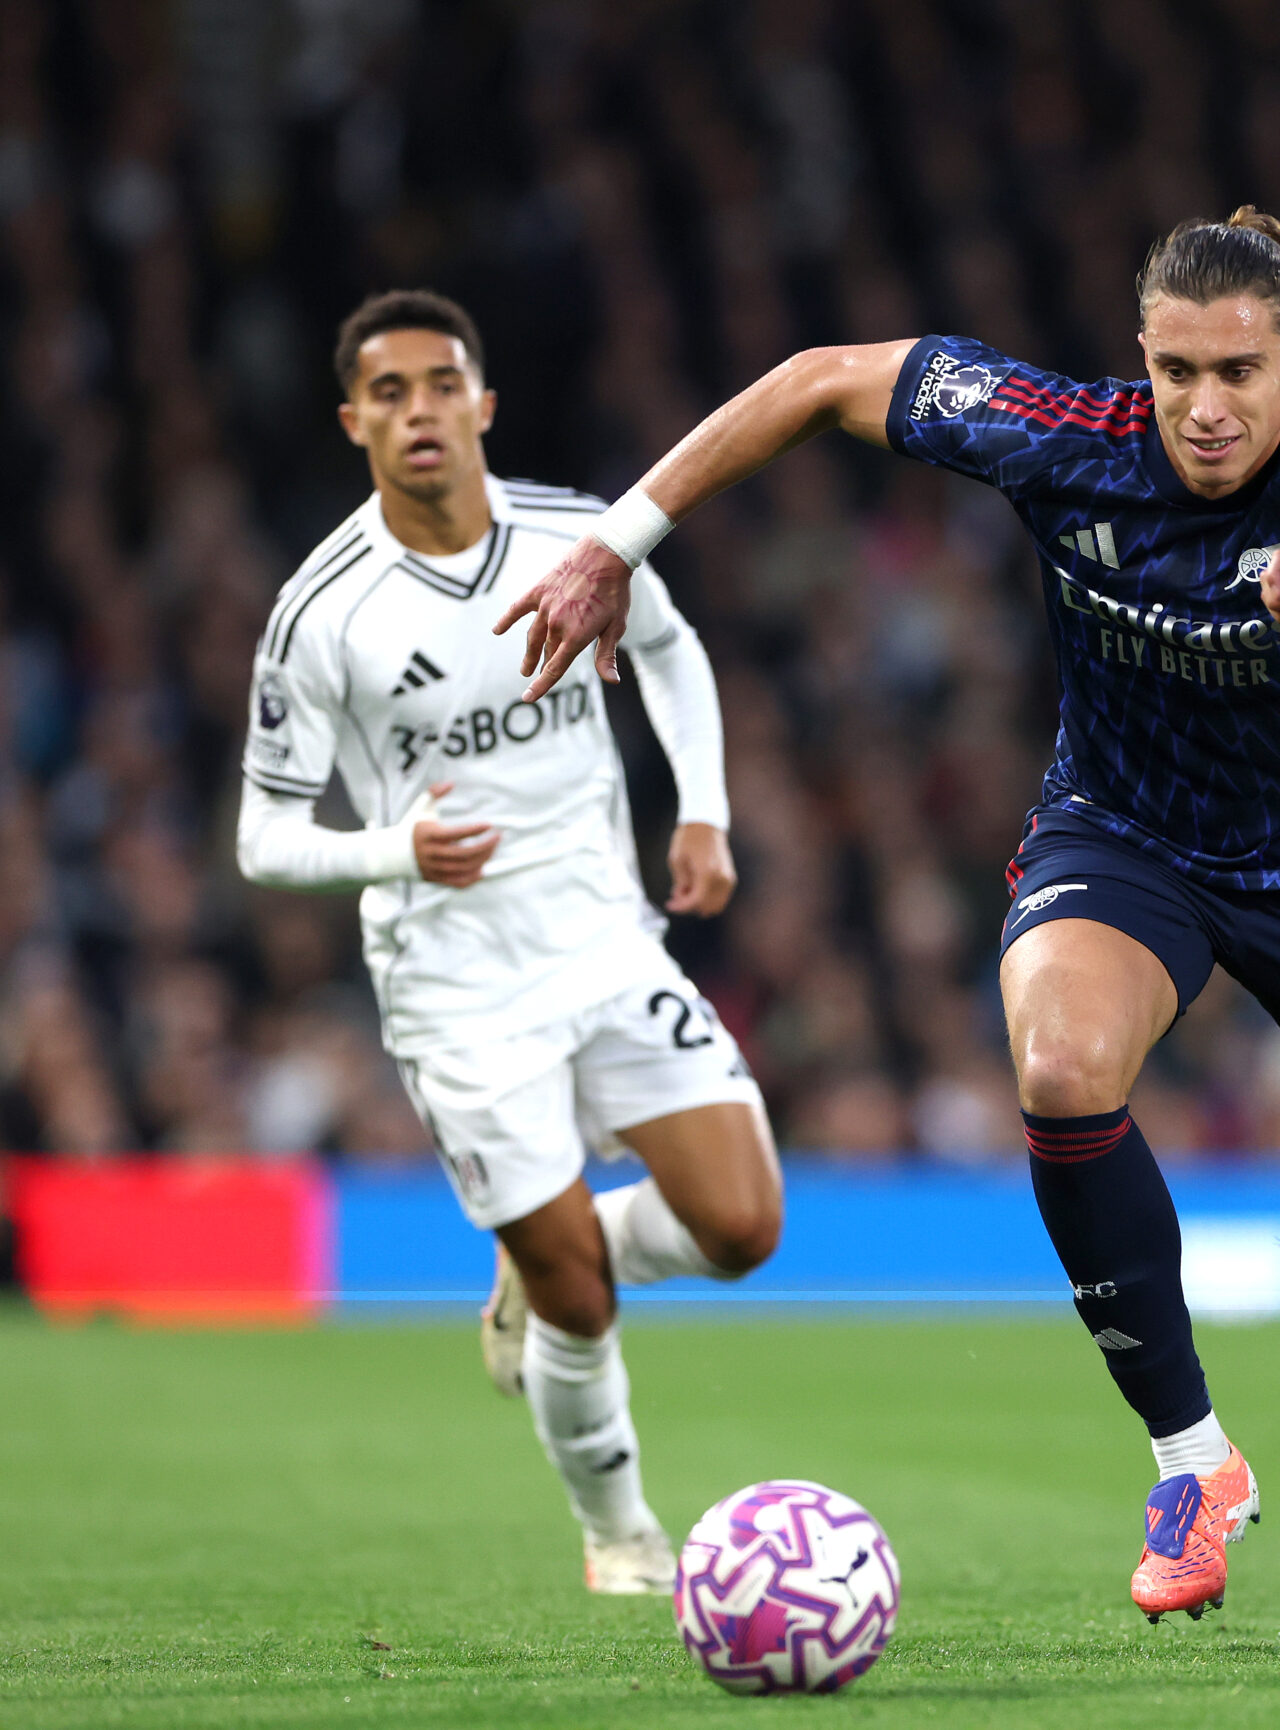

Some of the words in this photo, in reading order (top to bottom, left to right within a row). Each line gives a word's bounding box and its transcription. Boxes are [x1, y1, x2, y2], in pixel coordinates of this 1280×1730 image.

[910, 372, 935, 421] racism
[1100, 627, 1146, 668] FLY
[1159, 645, 1271, 687] BETTER
[442, 682, 597, 758] SBOTO
